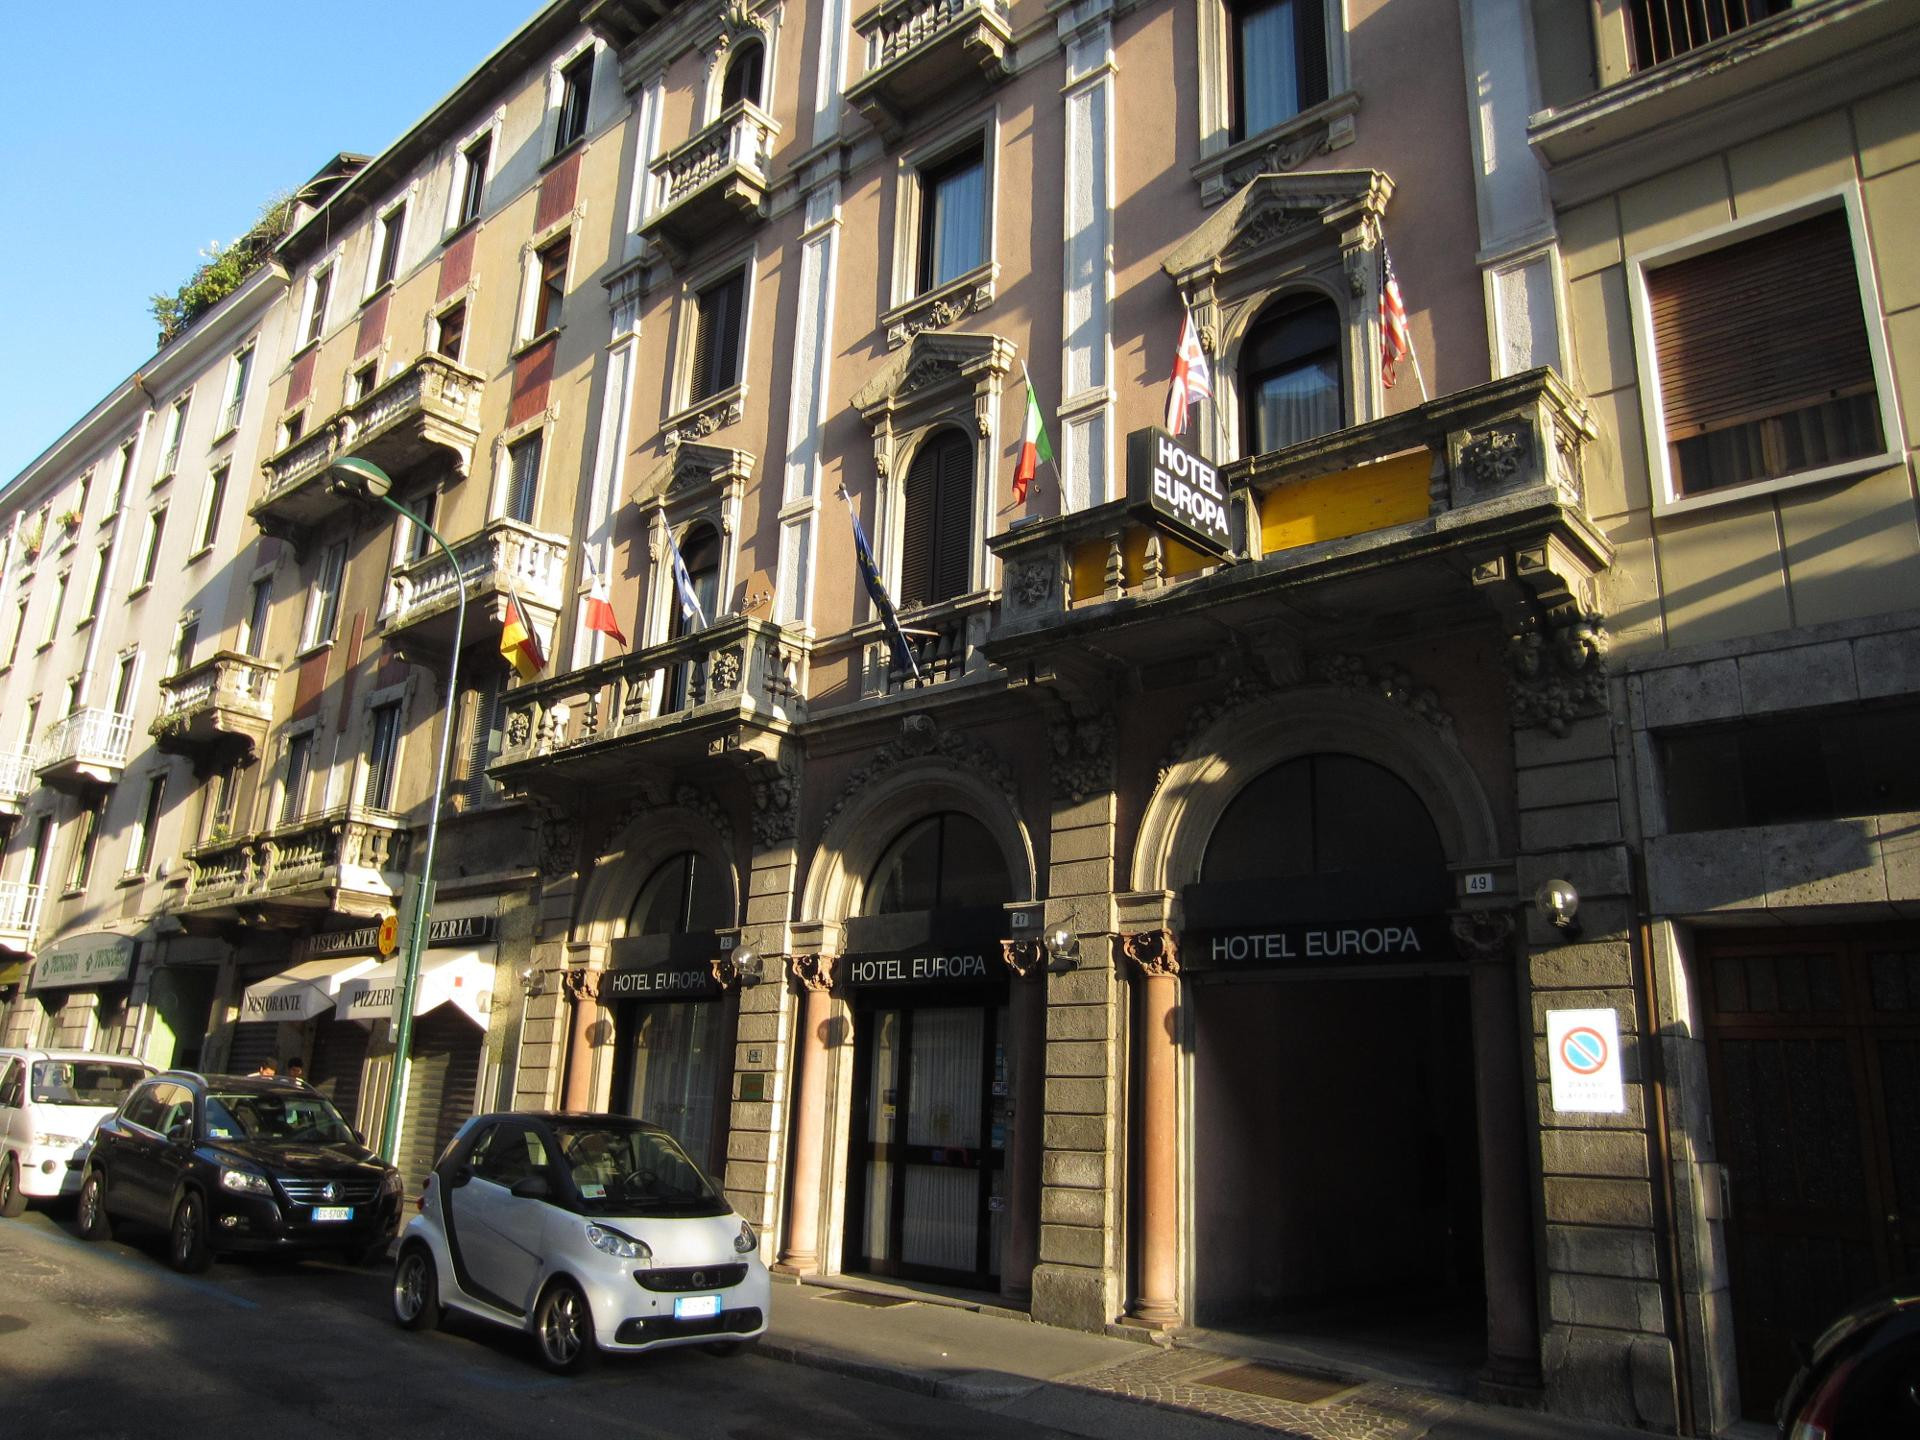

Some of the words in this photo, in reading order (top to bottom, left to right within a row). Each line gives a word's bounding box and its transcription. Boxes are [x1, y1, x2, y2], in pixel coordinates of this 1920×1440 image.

[1159, 437, 1223, 501] HOTEL
[1154, 467, 1229, 536] EUROPA
[1471, 876, 1487, 890] 49
[1014, 913, 1026, 925] 47
[308, 928, 377, 953] RISTORANTE
[430, 918, 473, 940] ZERIA
[1212, 933, 1296, 960] HOTEL
[1306, 927, 1421, 956] EUROPA
[851, 960, 907, 981] HOTEL
[913, 955, 987, 979] EUROPA
[612, 973, 651, 991] HOTEL
[655, 971, 707, 990] EUROPA
[247, 994, 302, 1013] RISTORANTE
[353, 989, 396, 1008] PIZZERI
